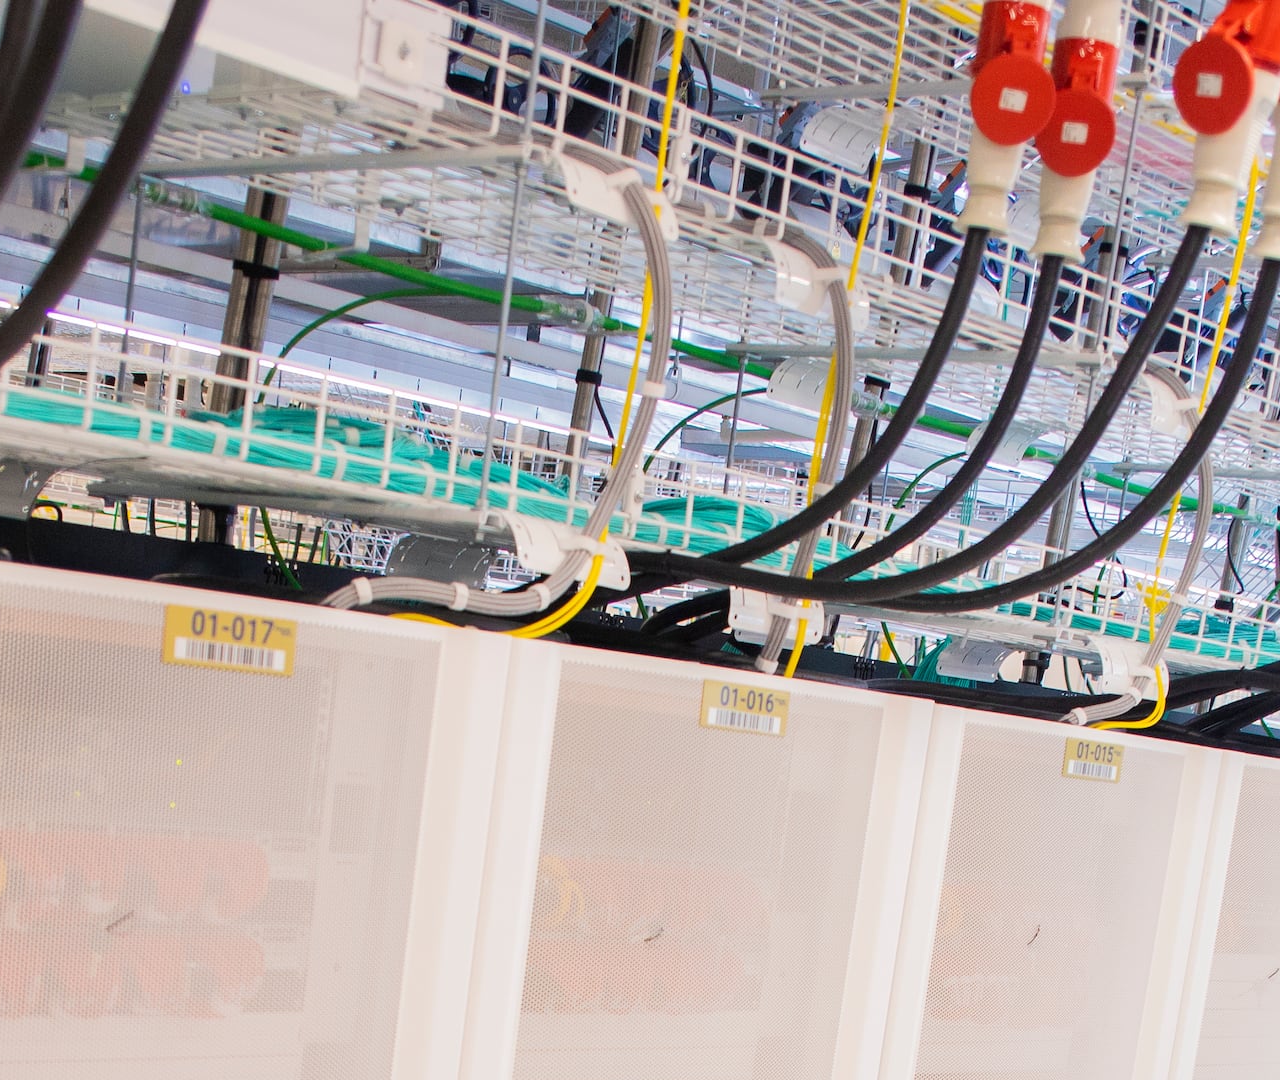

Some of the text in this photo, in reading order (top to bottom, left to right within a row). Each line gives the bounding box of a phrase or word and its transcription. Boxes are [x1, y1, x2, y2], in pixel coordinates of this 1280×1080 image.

[191, 609, 274, 645] 01-017
[720, 685, 775, 713] 01-016
[1077, 741, 1115, 763] 01-015
